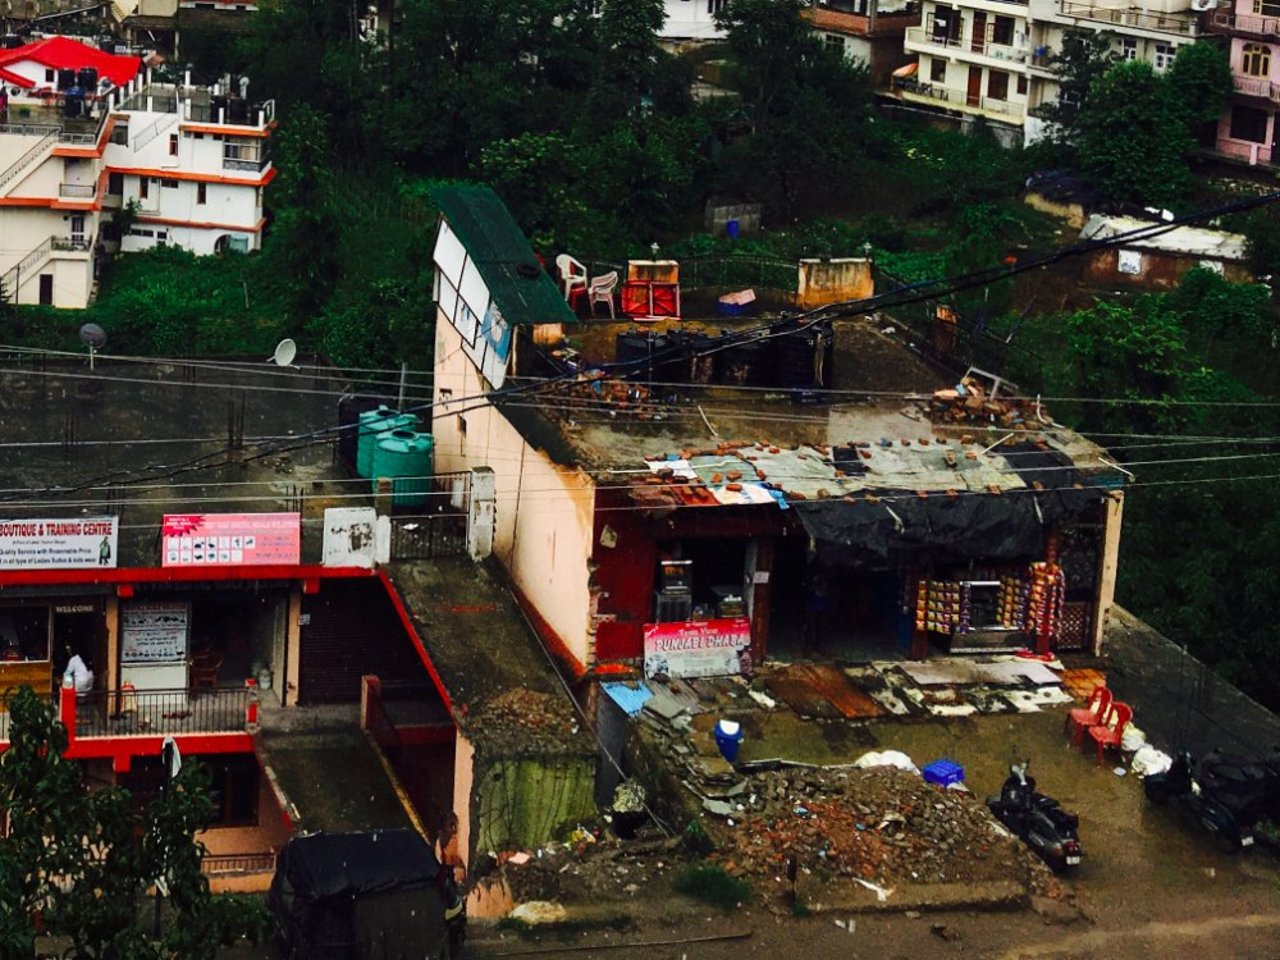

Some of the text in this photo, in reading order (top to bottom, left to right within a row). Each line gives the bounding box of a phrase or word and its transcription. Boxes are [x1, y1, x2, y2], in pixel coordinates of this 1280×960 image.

[38, 524, 45, 536] &
[46, 523, 82, 536] TRAINING
[83, 522, 113, 535] CENTRE
[55, 604, 94, 613] WELCOME
[656, 633, 745, 652] PUNJABI DHABA
